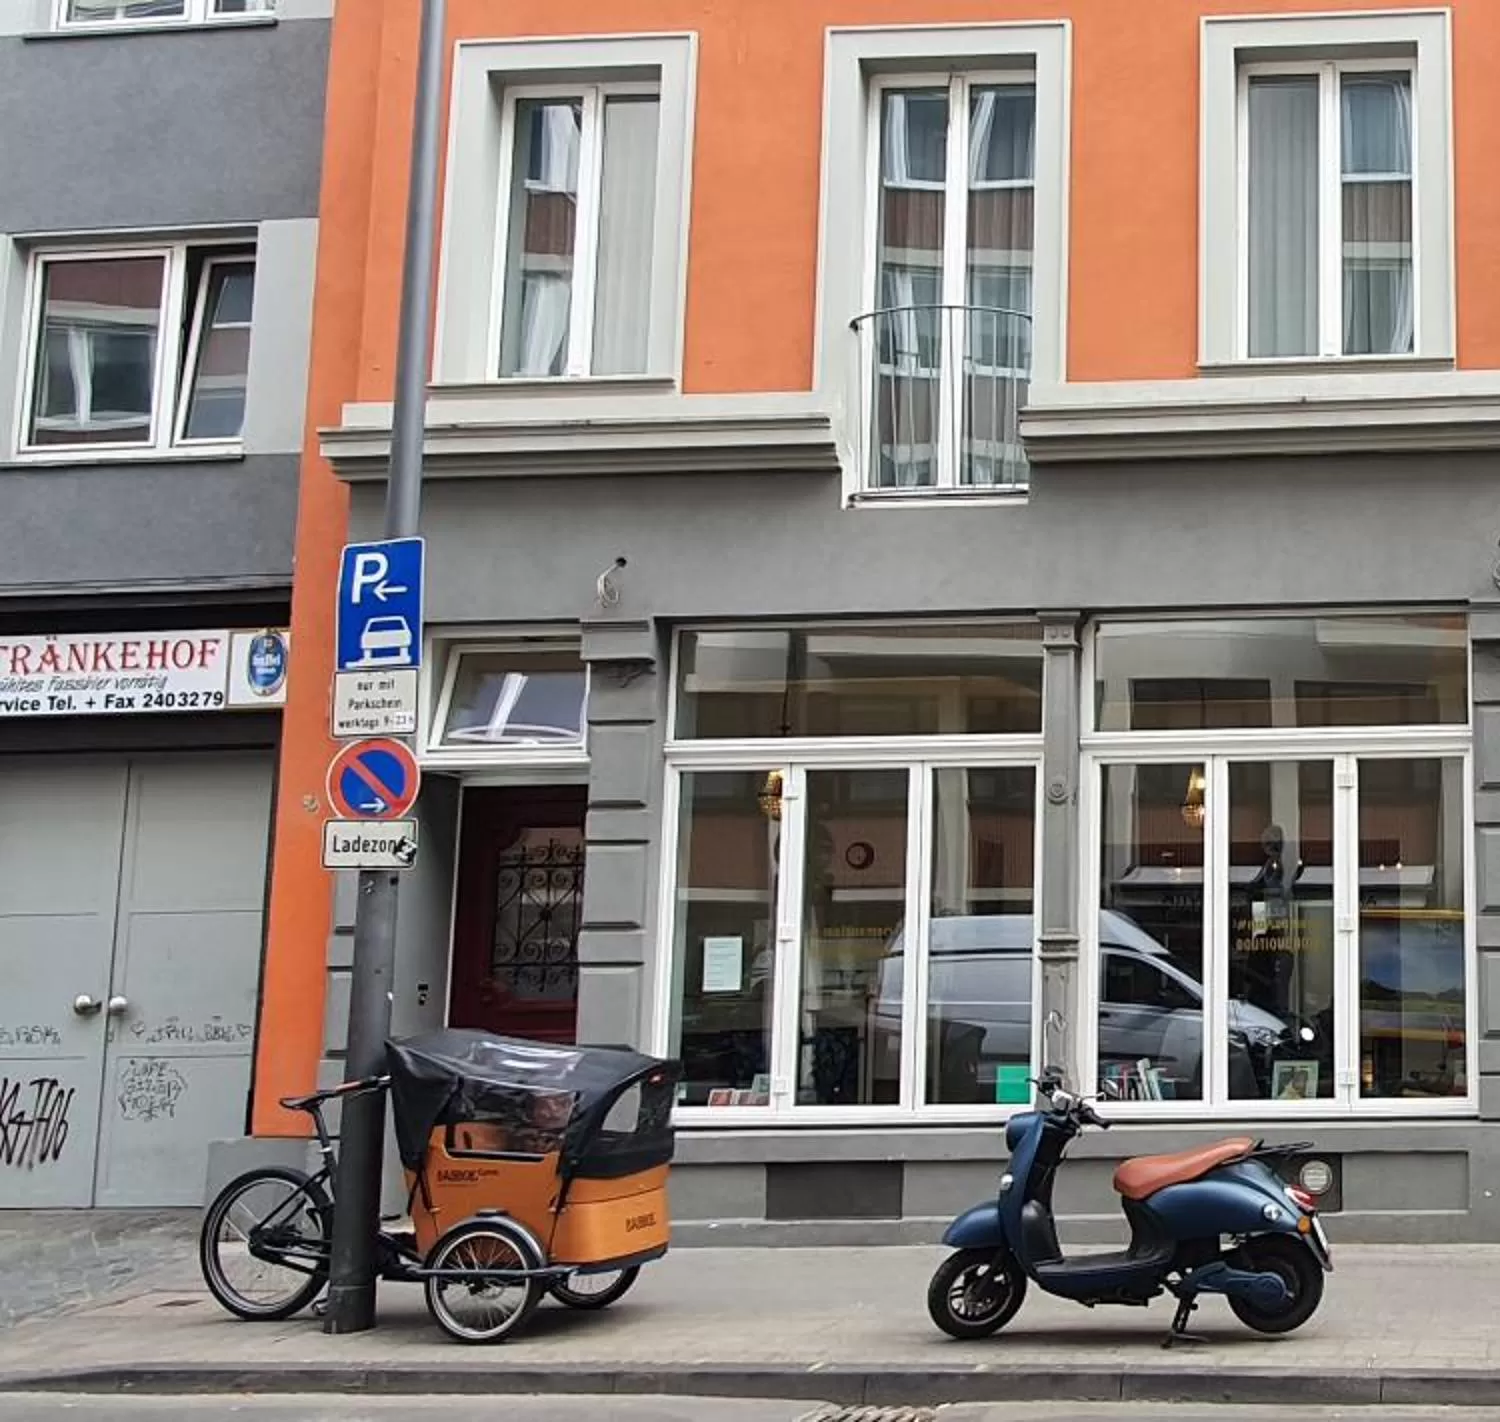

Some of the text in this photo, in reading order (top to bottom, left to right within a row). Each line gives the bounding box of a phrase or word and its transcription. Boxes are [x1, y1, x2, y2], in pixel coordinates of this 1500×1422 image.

[351, 553, 388, 603] P
[48, 695, 77, 711] Tel.
[104, 693, 135, 709] Fax
[348, 696, 402, 711] Parkschein
[339, 717, 379, 730] werktags
